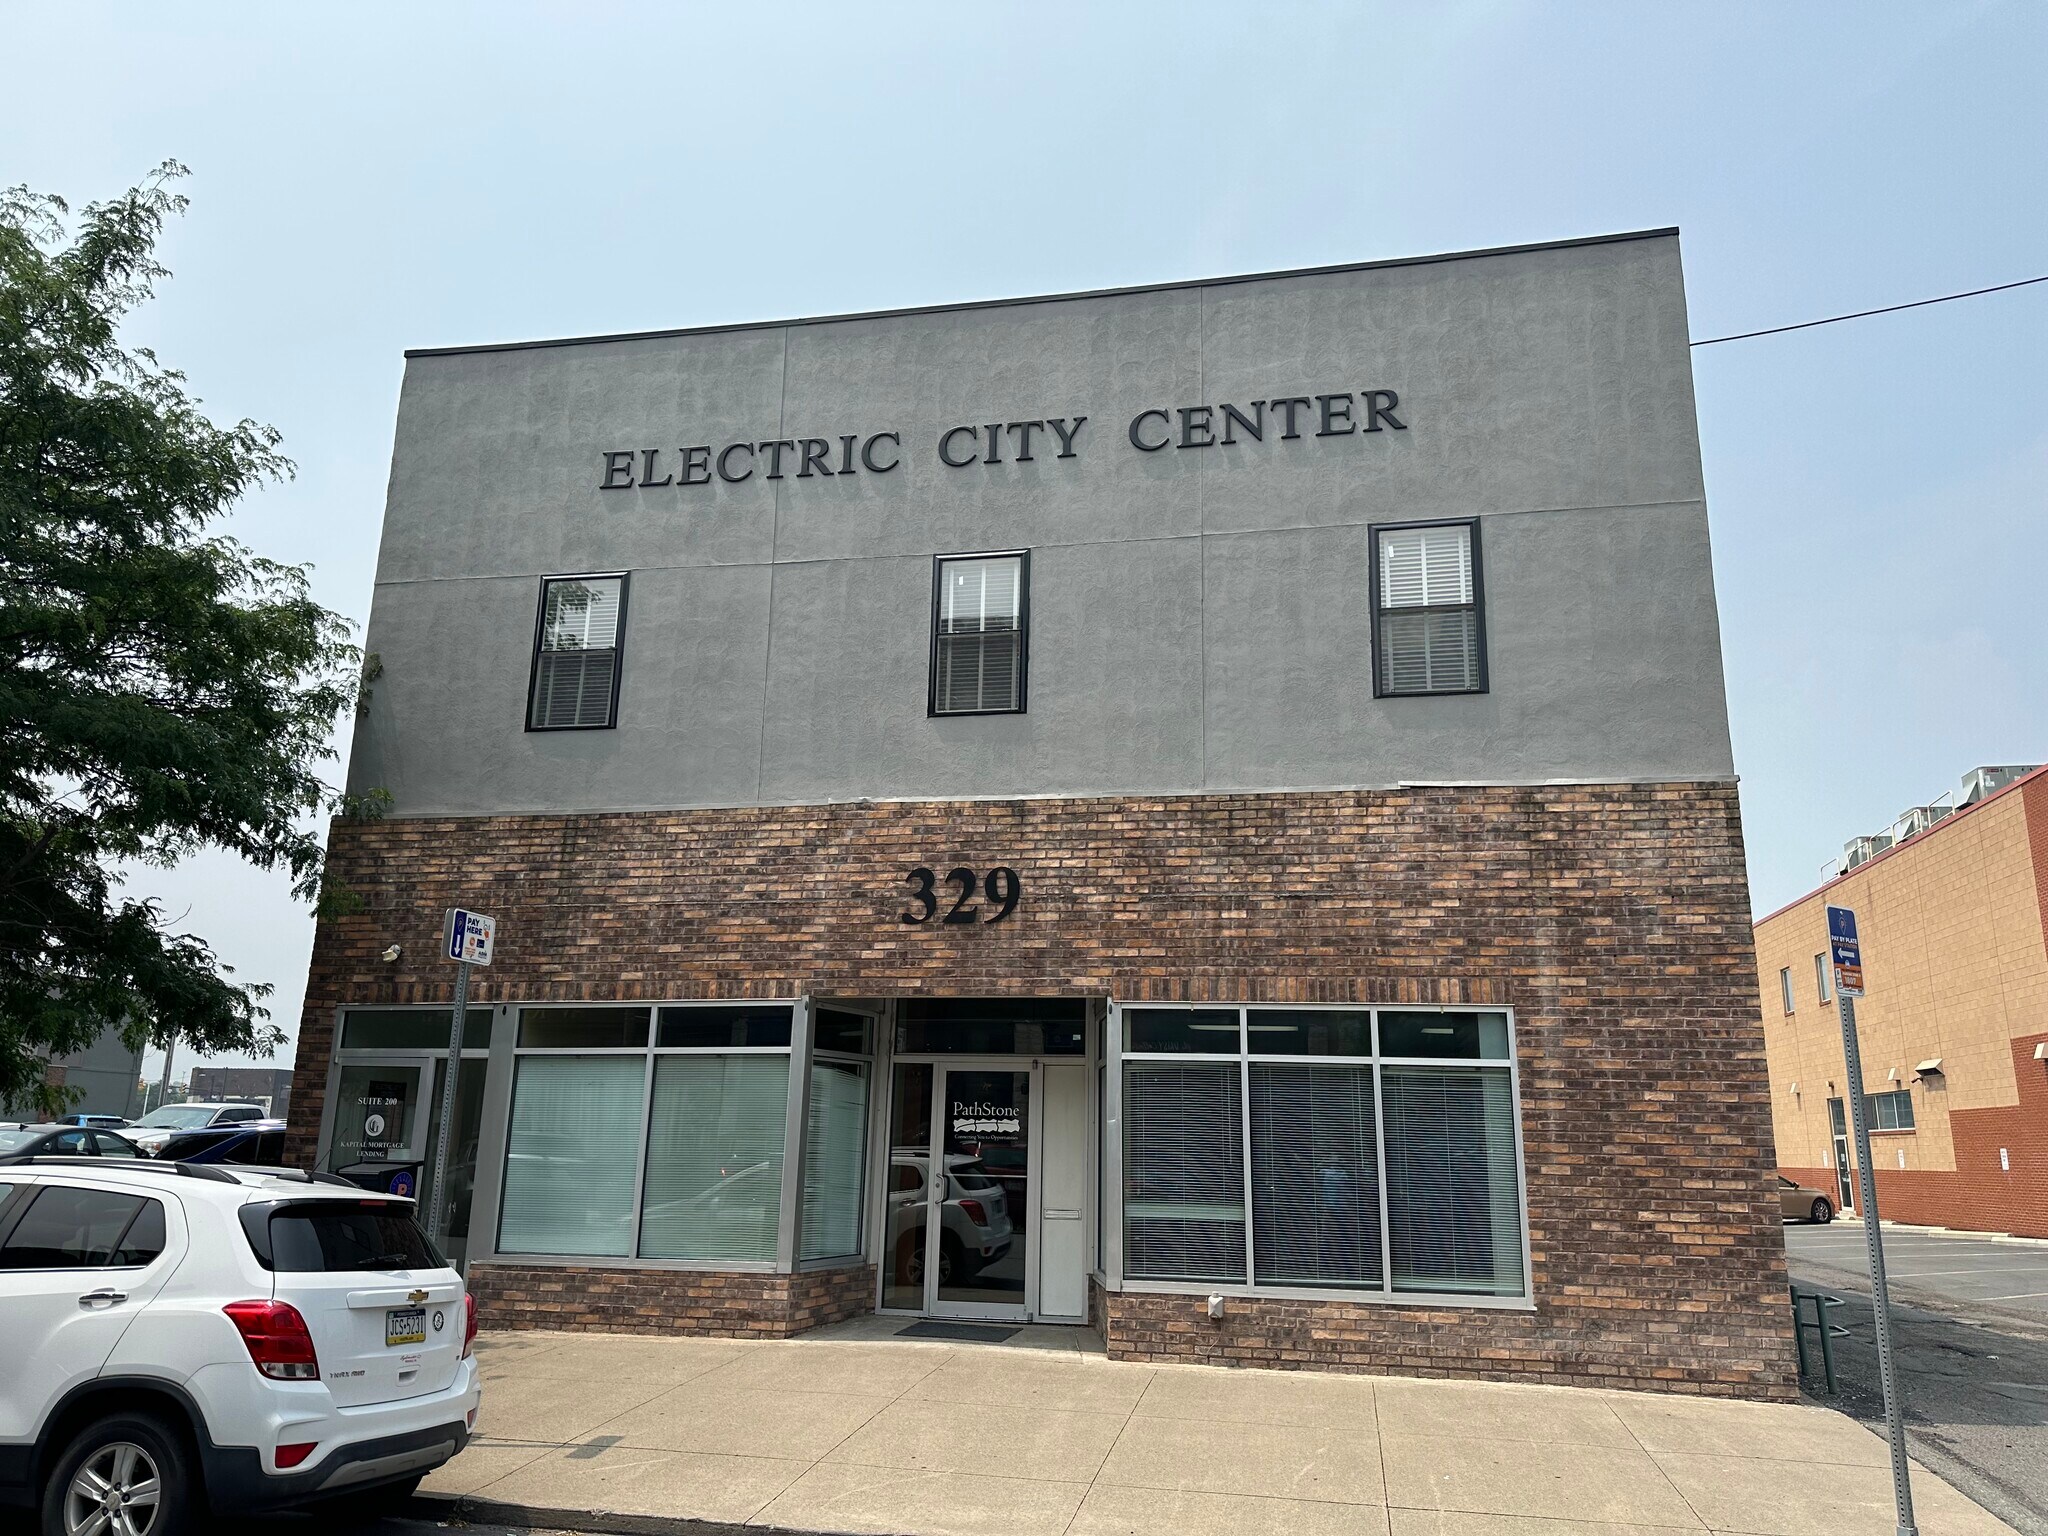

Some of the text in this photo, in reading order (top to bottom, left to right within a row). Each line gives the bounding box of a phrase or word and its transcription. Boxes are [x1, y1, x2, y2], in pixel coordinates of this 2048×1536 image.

[599, 388, 1407, 489] ELECTRIC CITY CENTER
[902, 866, 1021, 925] 329
[467, 917, 480, 927] PAY
[466, 926, 483, 936] HERE
[357, 1097, 398, 1106] SUITE 200
[953, 1101, 1020, 1117] PathStone
[368, 1141, 405, 1149] MORTGAGE
